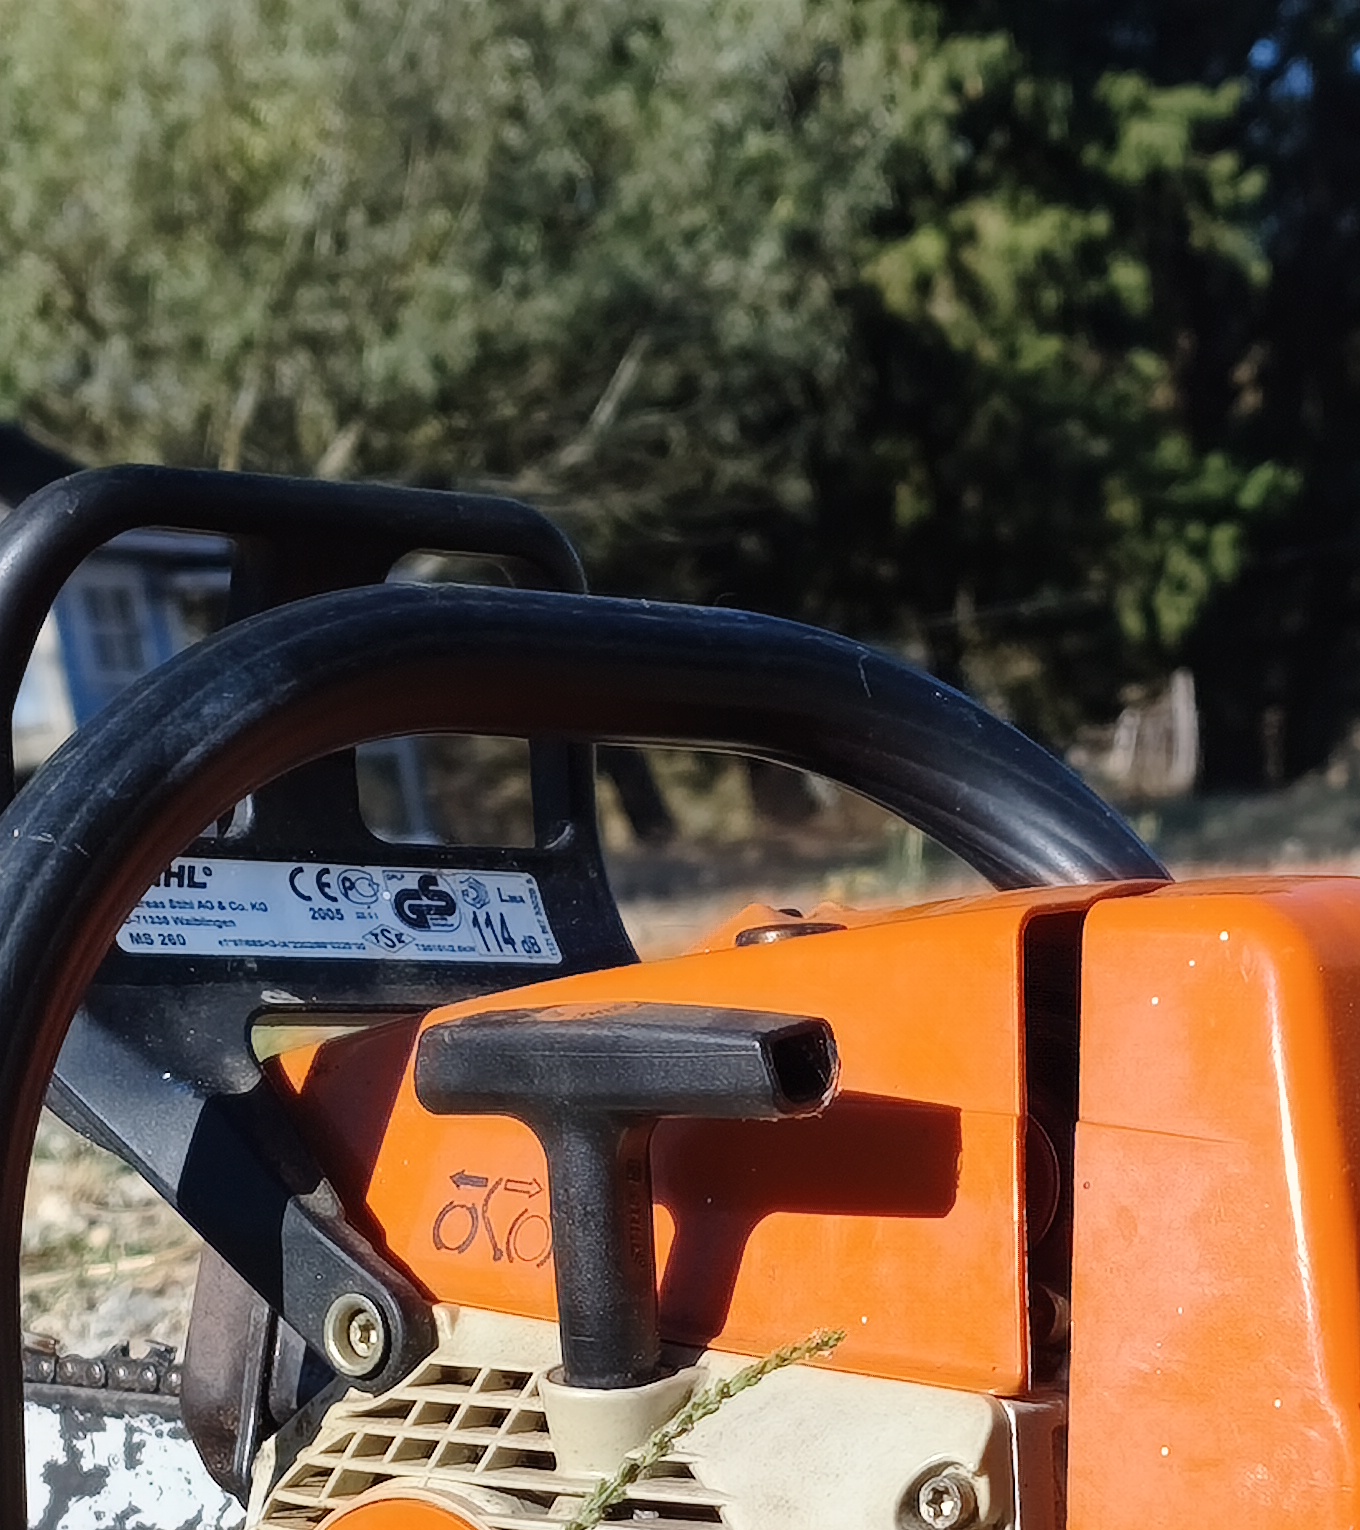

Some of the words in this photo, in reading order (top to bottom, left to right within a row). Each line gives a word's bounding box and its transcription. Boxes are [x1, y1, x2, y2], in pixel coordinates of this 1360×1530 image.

[308, 907, 344, 921] 2005
[129, 931, 154, 946] MS
[158, 932, 187, 947] 260
[472, 910, 517, 953] 114
[521, 934, 542, 954] dB
